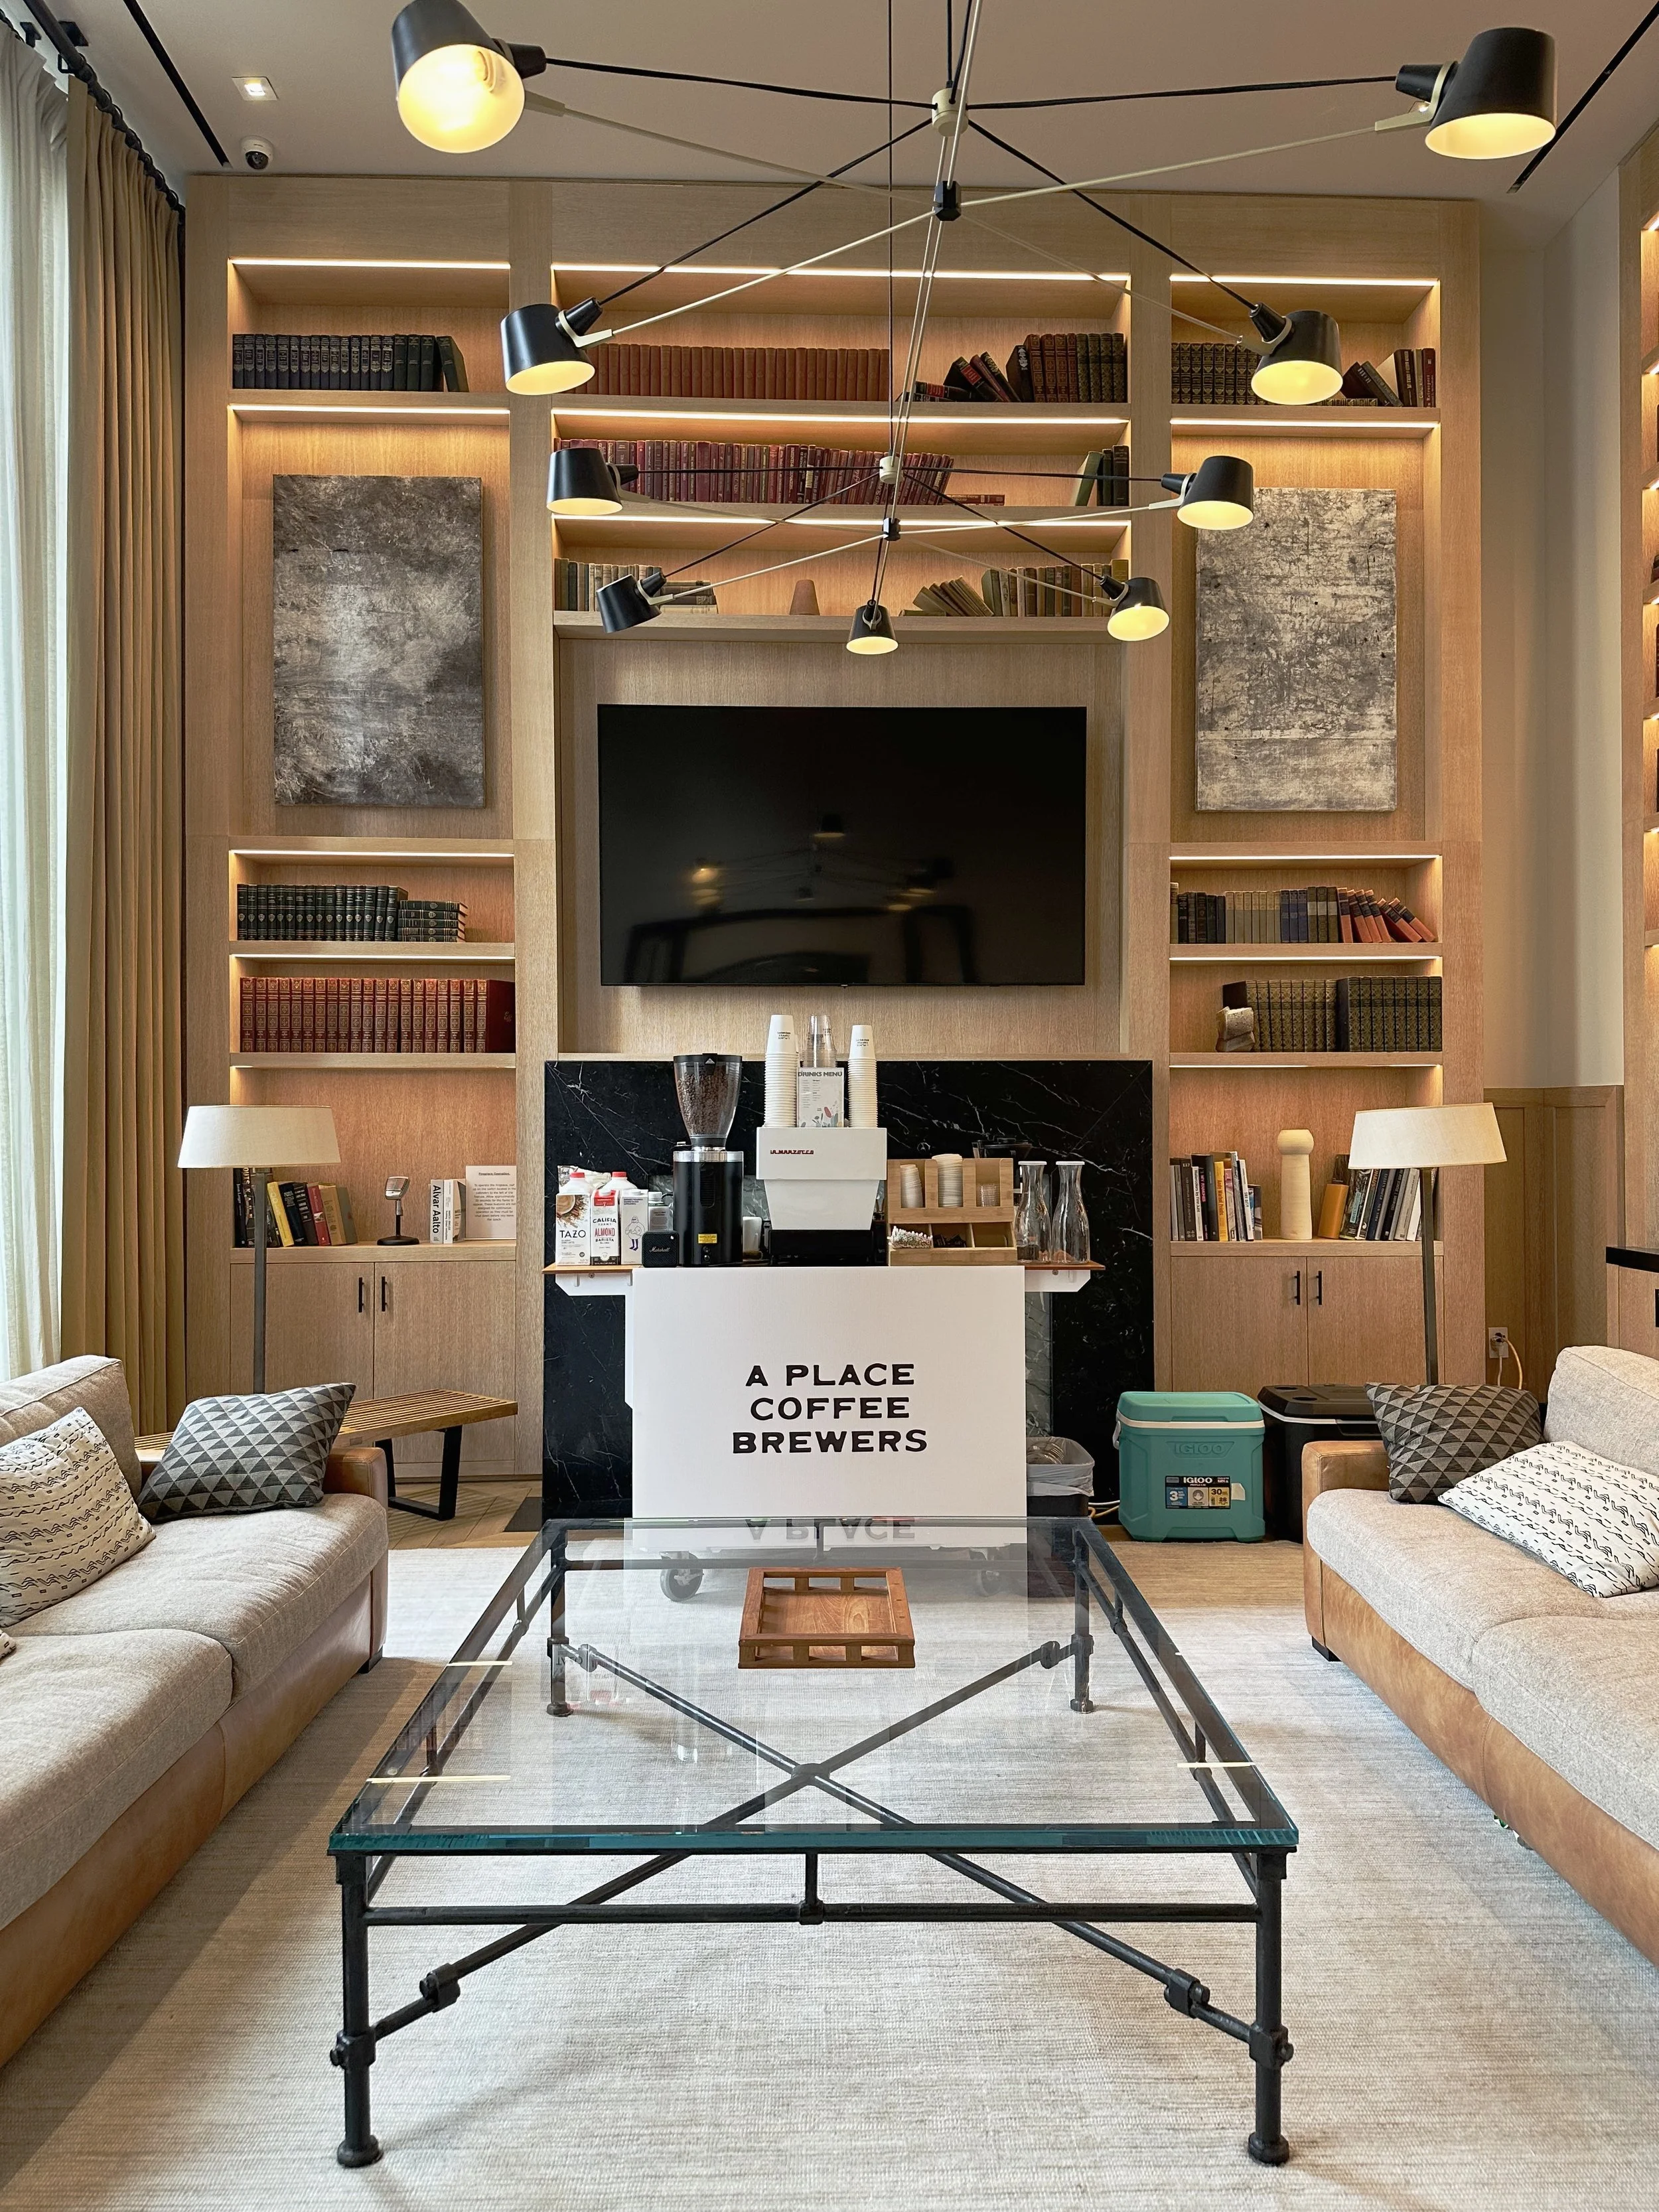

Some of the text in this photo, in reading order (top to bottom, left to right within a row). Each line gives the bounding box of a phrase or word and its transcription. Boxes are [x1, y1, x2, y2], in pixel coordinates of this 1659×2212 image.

[559, 1230, 587, 1238] TAZO
[595, 1228, 615, 1237] ALMOND
[745, 1363, 914, 1386] A PLACE
[751, 1397, 909, 1420] COFFEE
[733, 1429, 927, 1453] BREWERS
[1175, 1443, 1224, 1454] IGLOO
[1169, 1491, 1179, 1501] 3
